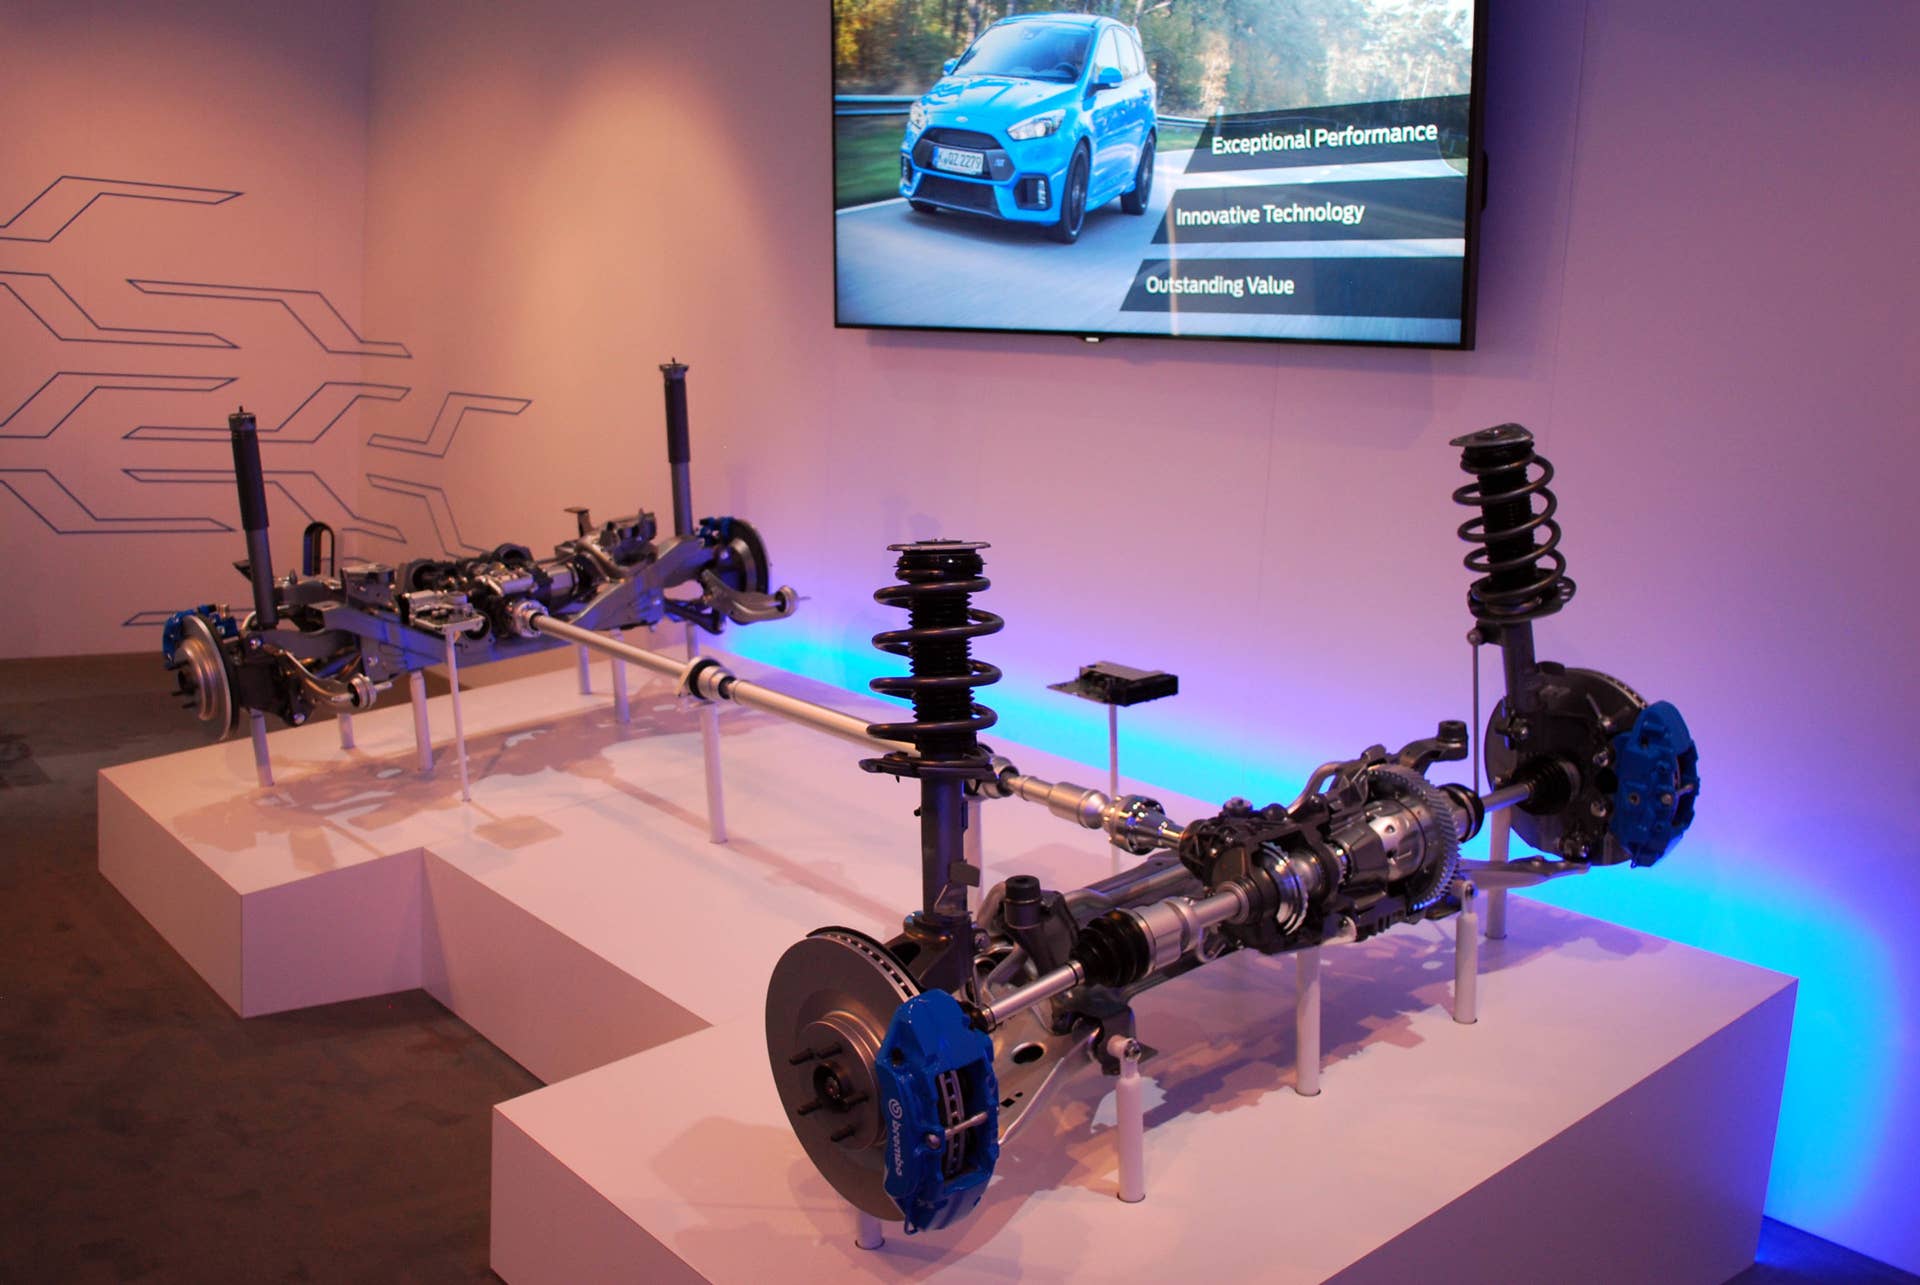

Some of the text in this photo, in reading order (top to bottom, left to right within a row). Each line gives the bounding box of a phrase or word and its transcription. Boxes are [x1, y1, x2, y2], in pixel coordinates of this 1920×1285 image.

[1211, 124, 1438, 156] Exceptional Performance
[1176, 202, 1365, 226] Innovative Technology
[1145, 275, 1294, 297] Outstanding Value
[892, 1120, 904, 1176] brembo
